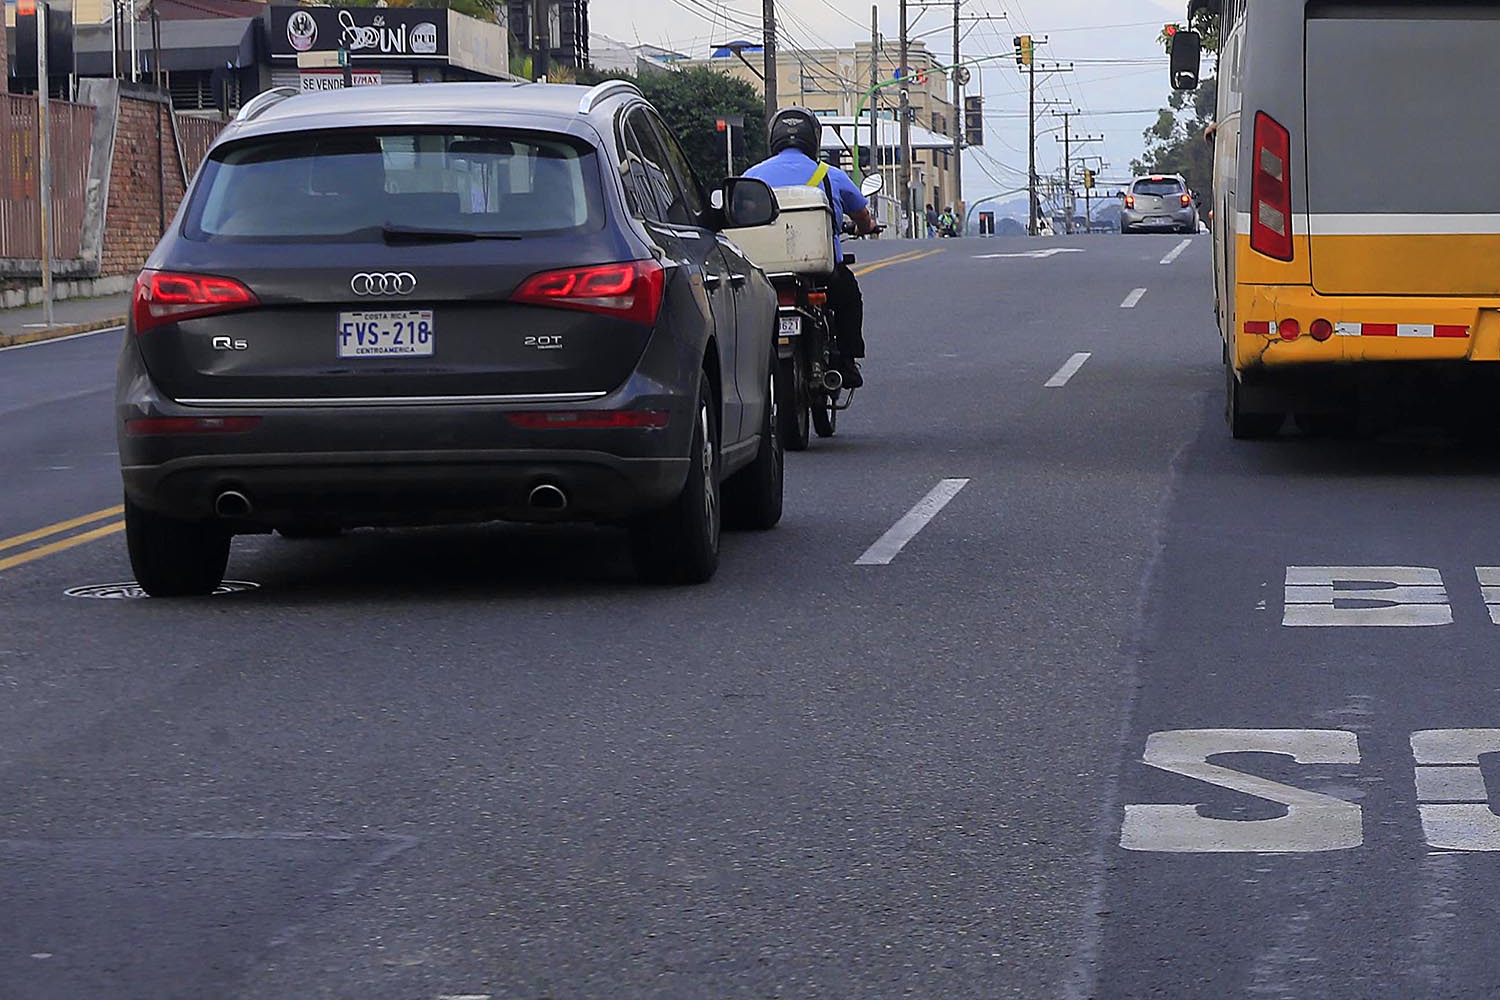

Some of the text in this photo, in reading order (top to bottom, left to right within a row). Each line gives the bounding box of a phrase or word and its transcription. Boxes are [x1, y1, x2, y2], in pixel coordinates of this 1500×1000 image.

[303, 78, 344, 91] SE VENDE
[343, 321, 429, 346] FVS-218
[213, 336, 248, 350] Q5
